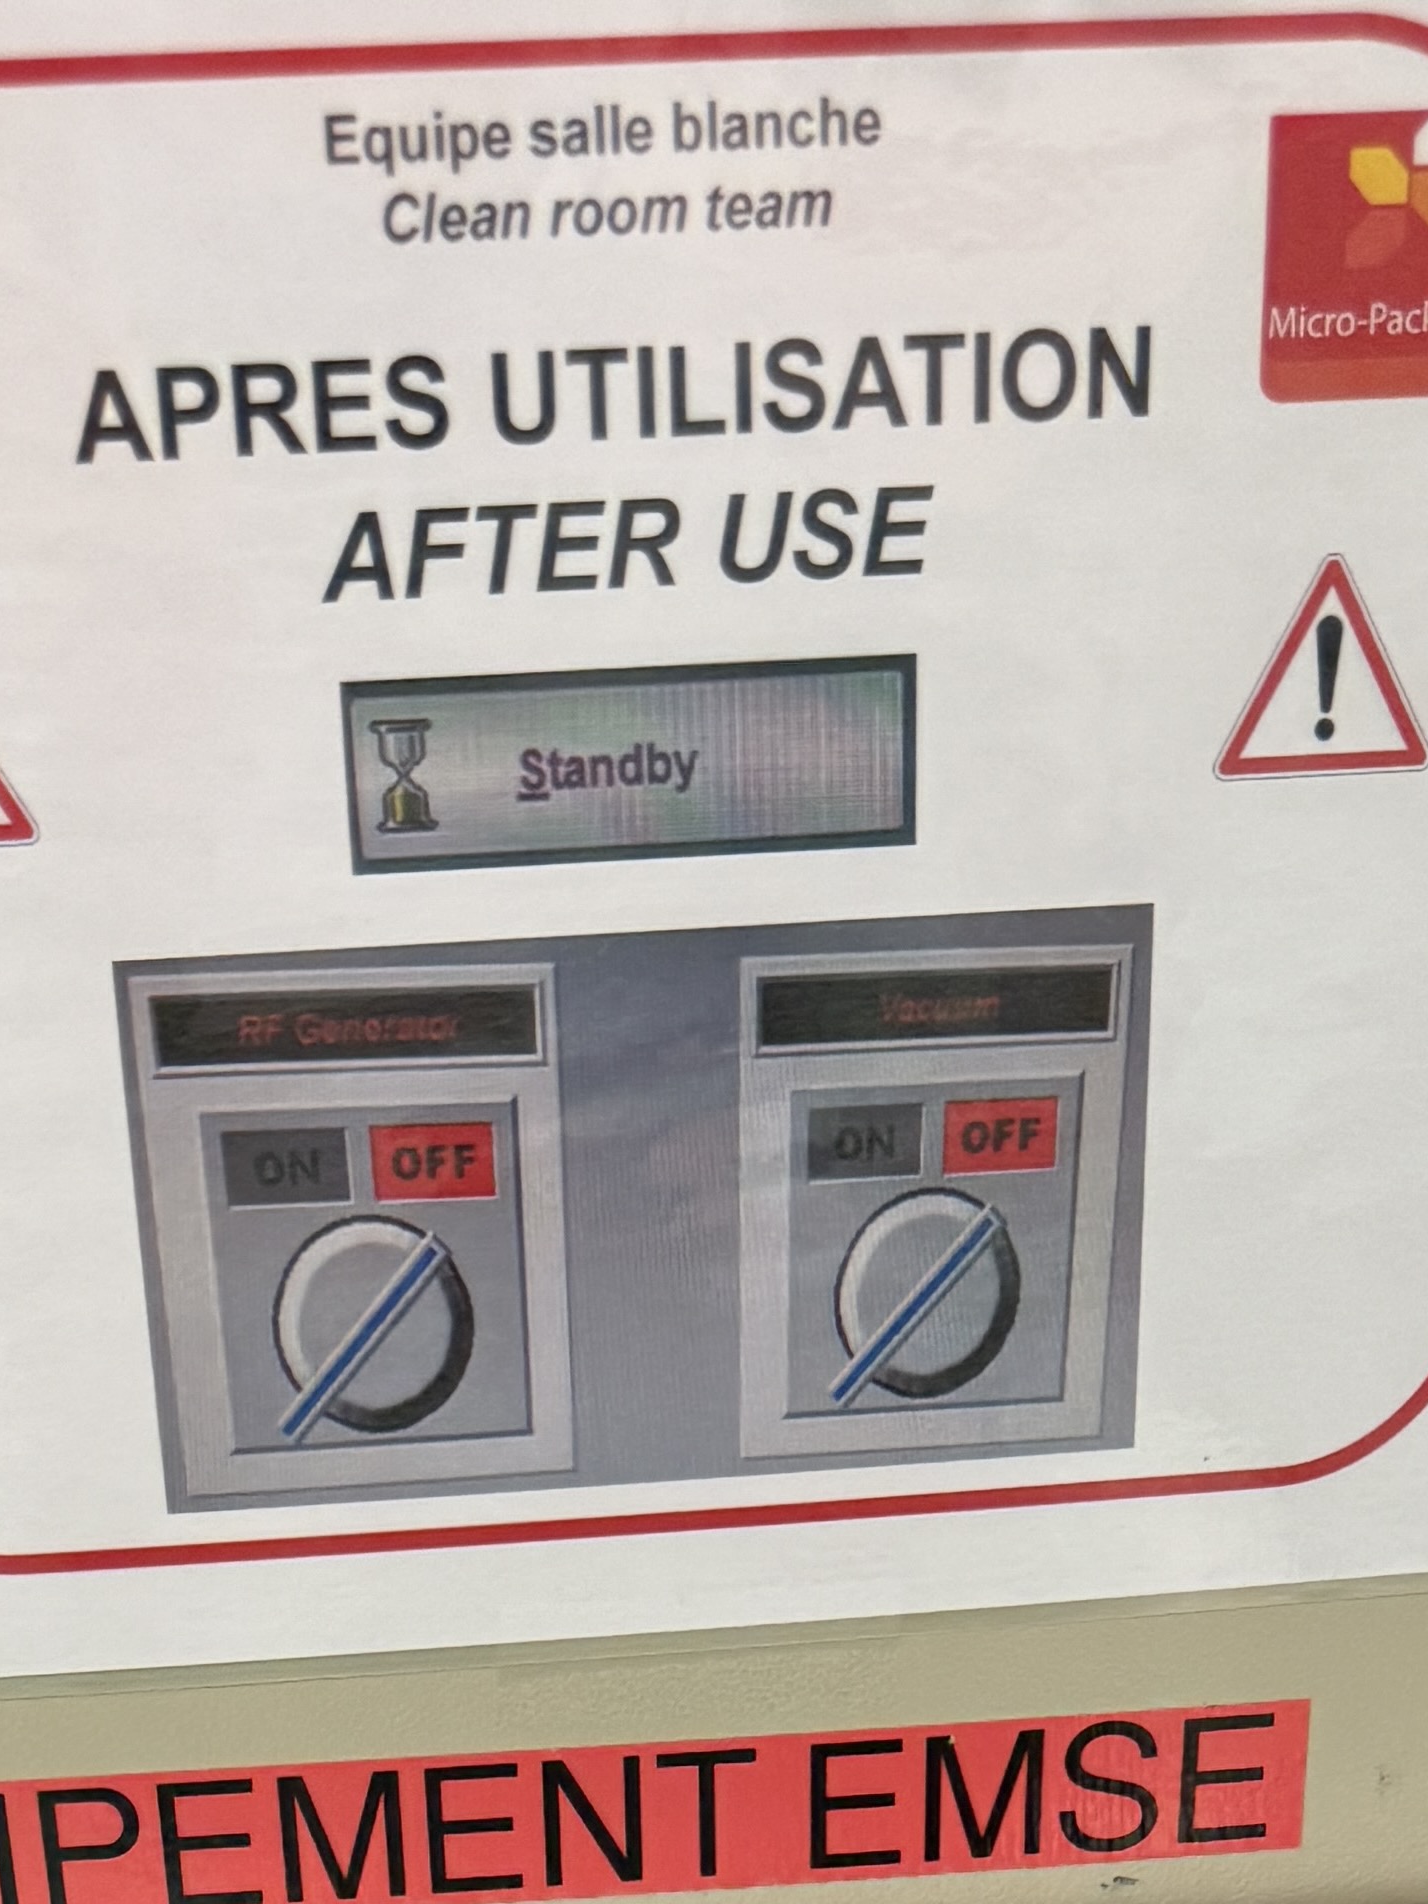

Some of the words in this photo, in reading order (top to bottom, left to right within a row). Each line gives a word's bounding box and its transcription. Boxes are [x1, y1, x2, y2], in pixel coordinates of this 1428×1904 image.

[324, 110, 513, 176] Equipe
[528, 103, 654, 158] salle
[671, 96, 883, 152] blanche
[382, 191, 533, 245] Clean
[551, 196, 689, 240] room
[701, 185, 835, 233] team
[76, 354, 450, 465] APRES
[489, 325, 1154, 446] UTILISATION
[322, 495, 683, 605] AFTER
[718, 483, 937, 586] USE
[517, 742, 700, 802] Standby
[253, 1148, 322, 1188] ON
[391, 1142, 478, 1182] OFF
[833, 1125, 897, 1162] ON
[960, 1116, 1043, 1156] OFF
[808, 1712, 1277, 1871] EMSE
